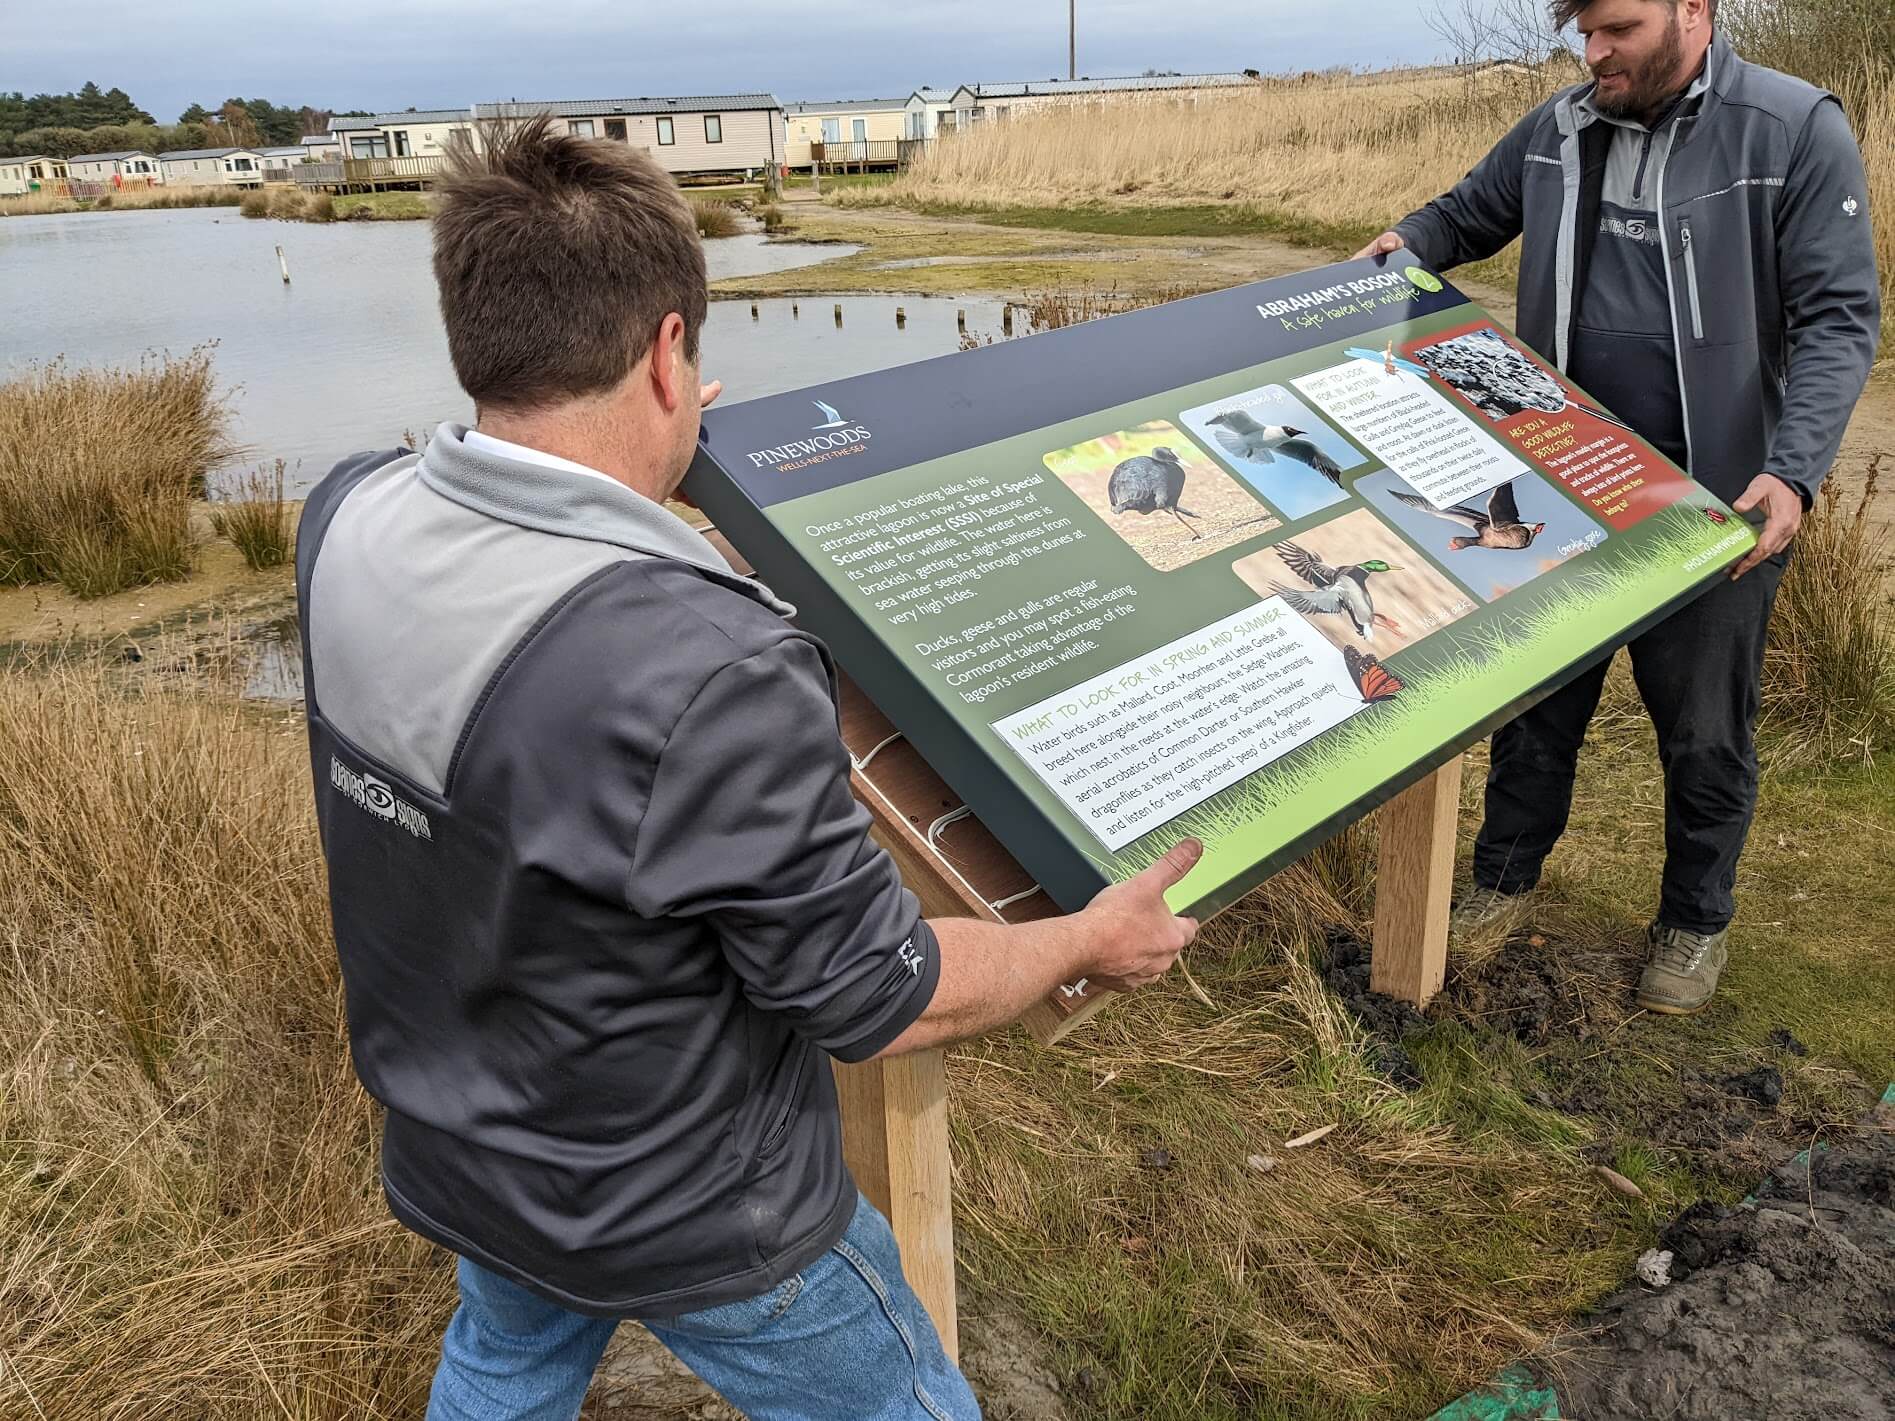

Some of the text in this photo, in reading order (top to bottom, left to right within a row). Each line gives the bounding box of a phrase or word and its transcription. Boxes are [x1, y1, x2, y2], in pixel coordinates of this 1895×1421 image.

[1257, 272, 1405, 318] ABRAHAM'S BOSOM
[1280, 285, 1419, 330] A safe haven for wildlife
[1413, 271, 1434, 289] 2
[748, 426, 870, 466] PINEWOODS
[776, 445, 867, 471] WELLS-NEXT-THE-SEA
[1509, 426, 1525, 438] ARE
[1523, 420, 1540, 431] YOU
[1522, 421, 1574, 448] GOOD WILDLIFE
[1533, 435, 1577, 458] DETECTIVE?
[806, 476, 989, 536] Once a popular boating lake, this
[820, 529, 878, 551] attractive
[876, 516, 918, 533] lagoon
[918, 512, 930, 520] is
[930, 504, 955, 516] now
[964, 493, 990, 505] Site
[991, 486, 1004, 497] of
[1002, 474, 1043, 493] Special
[832, 492, 1037, 565] Scientific Interest (SSSI) because of
[845, 506, 1053, 581] its value for wildlife. The water here is
[858, 518, 1071, 595] brackish, getting its slight saltiness from
[875, 530, 1086, 610] sea water seeping through the dunes at
[888, 589, 977, 624] very high tides.
[915, 580, 1097, 655] Ducks, geese and gulls are regular
[932, 585, 1137, 670] visitors and you may spot a fish-eating
[946, 605, 1135, 685] Cormorant taking advantage of the
[959, 640, 1099, 703] lagoon's resident wildlife.
[1012, 608, 1286, 739] WHAT TO LOOK FOR IN SPRING AND SUMMER
[1027, 627, 1287, 754] Water birds such as Mallard, Coot, Moorhen and Little Grebe all
[1043, 642, 1300, 771] breed here alongside their noisy neighbours, the Sedge Warblers,
[1075, 678, 1304, 802] aerial acrobatics of Common Darter or Southern Hawker
[1106, 818, 1126, 835] and
[1123, 807, 1152, 824] listen
[1149, 798, 1165, 809] for
[1165, 789, 1184, 801] the
[1180, 758, 1235, 792] high-pitched
[1232, 744, 1258, 765] 'peep'
[1259, 738, 1269, 749] of
[1273, 717, 1312, 741] Kingfisher.
[395, 799, 432, 838] signs
